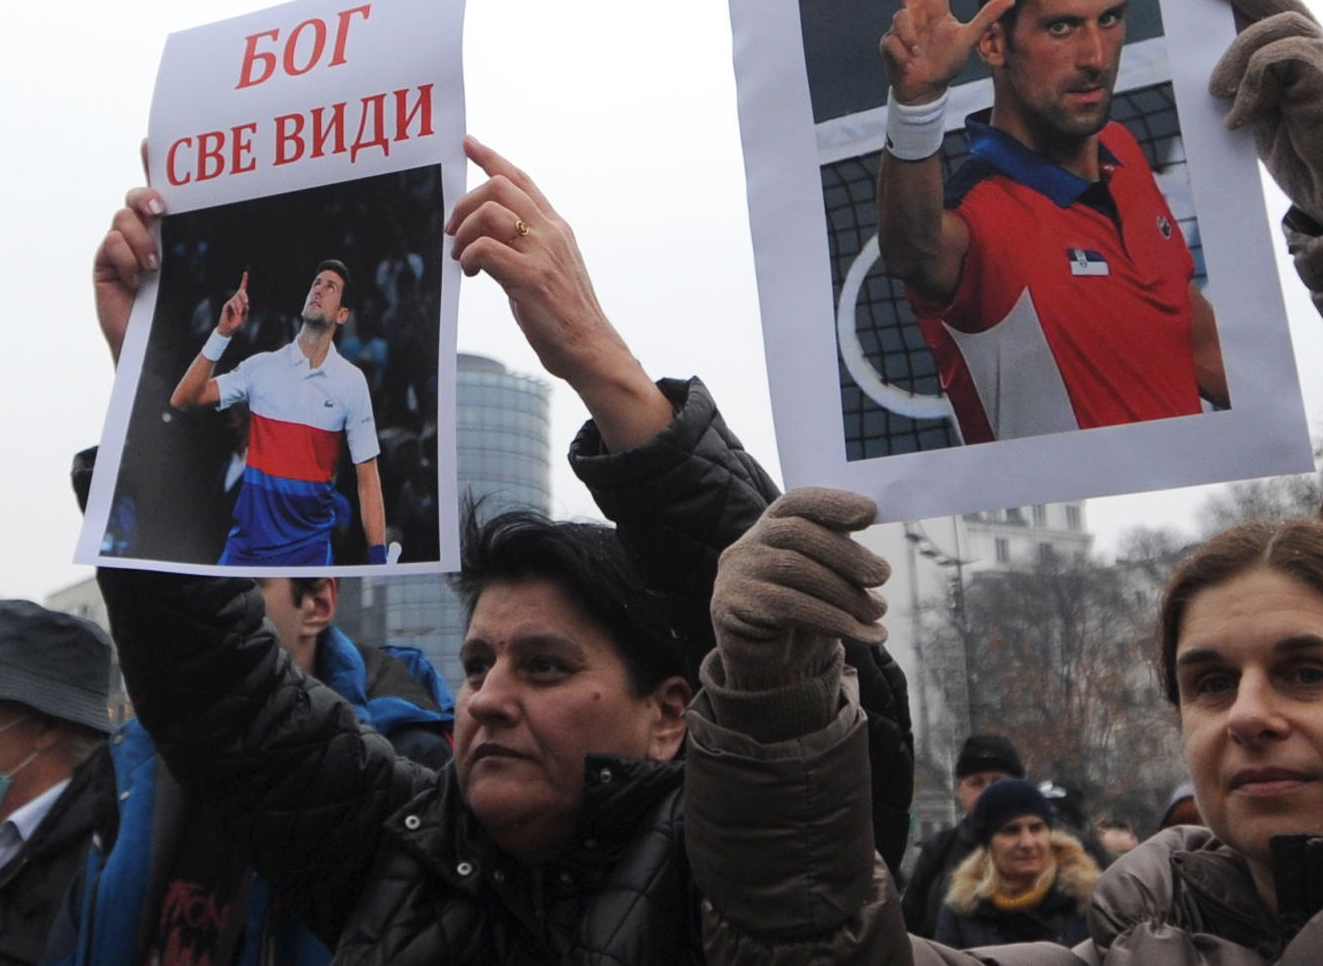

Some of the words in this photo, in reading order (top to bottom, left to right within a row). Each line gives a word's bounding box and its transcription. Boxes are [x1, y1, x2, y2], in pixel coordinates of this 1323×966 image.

[235, 3, 372, 90] БОГ
[165, 121, 259, 187] СВЕ
[273, 84, 435, 167] ВИДИ
